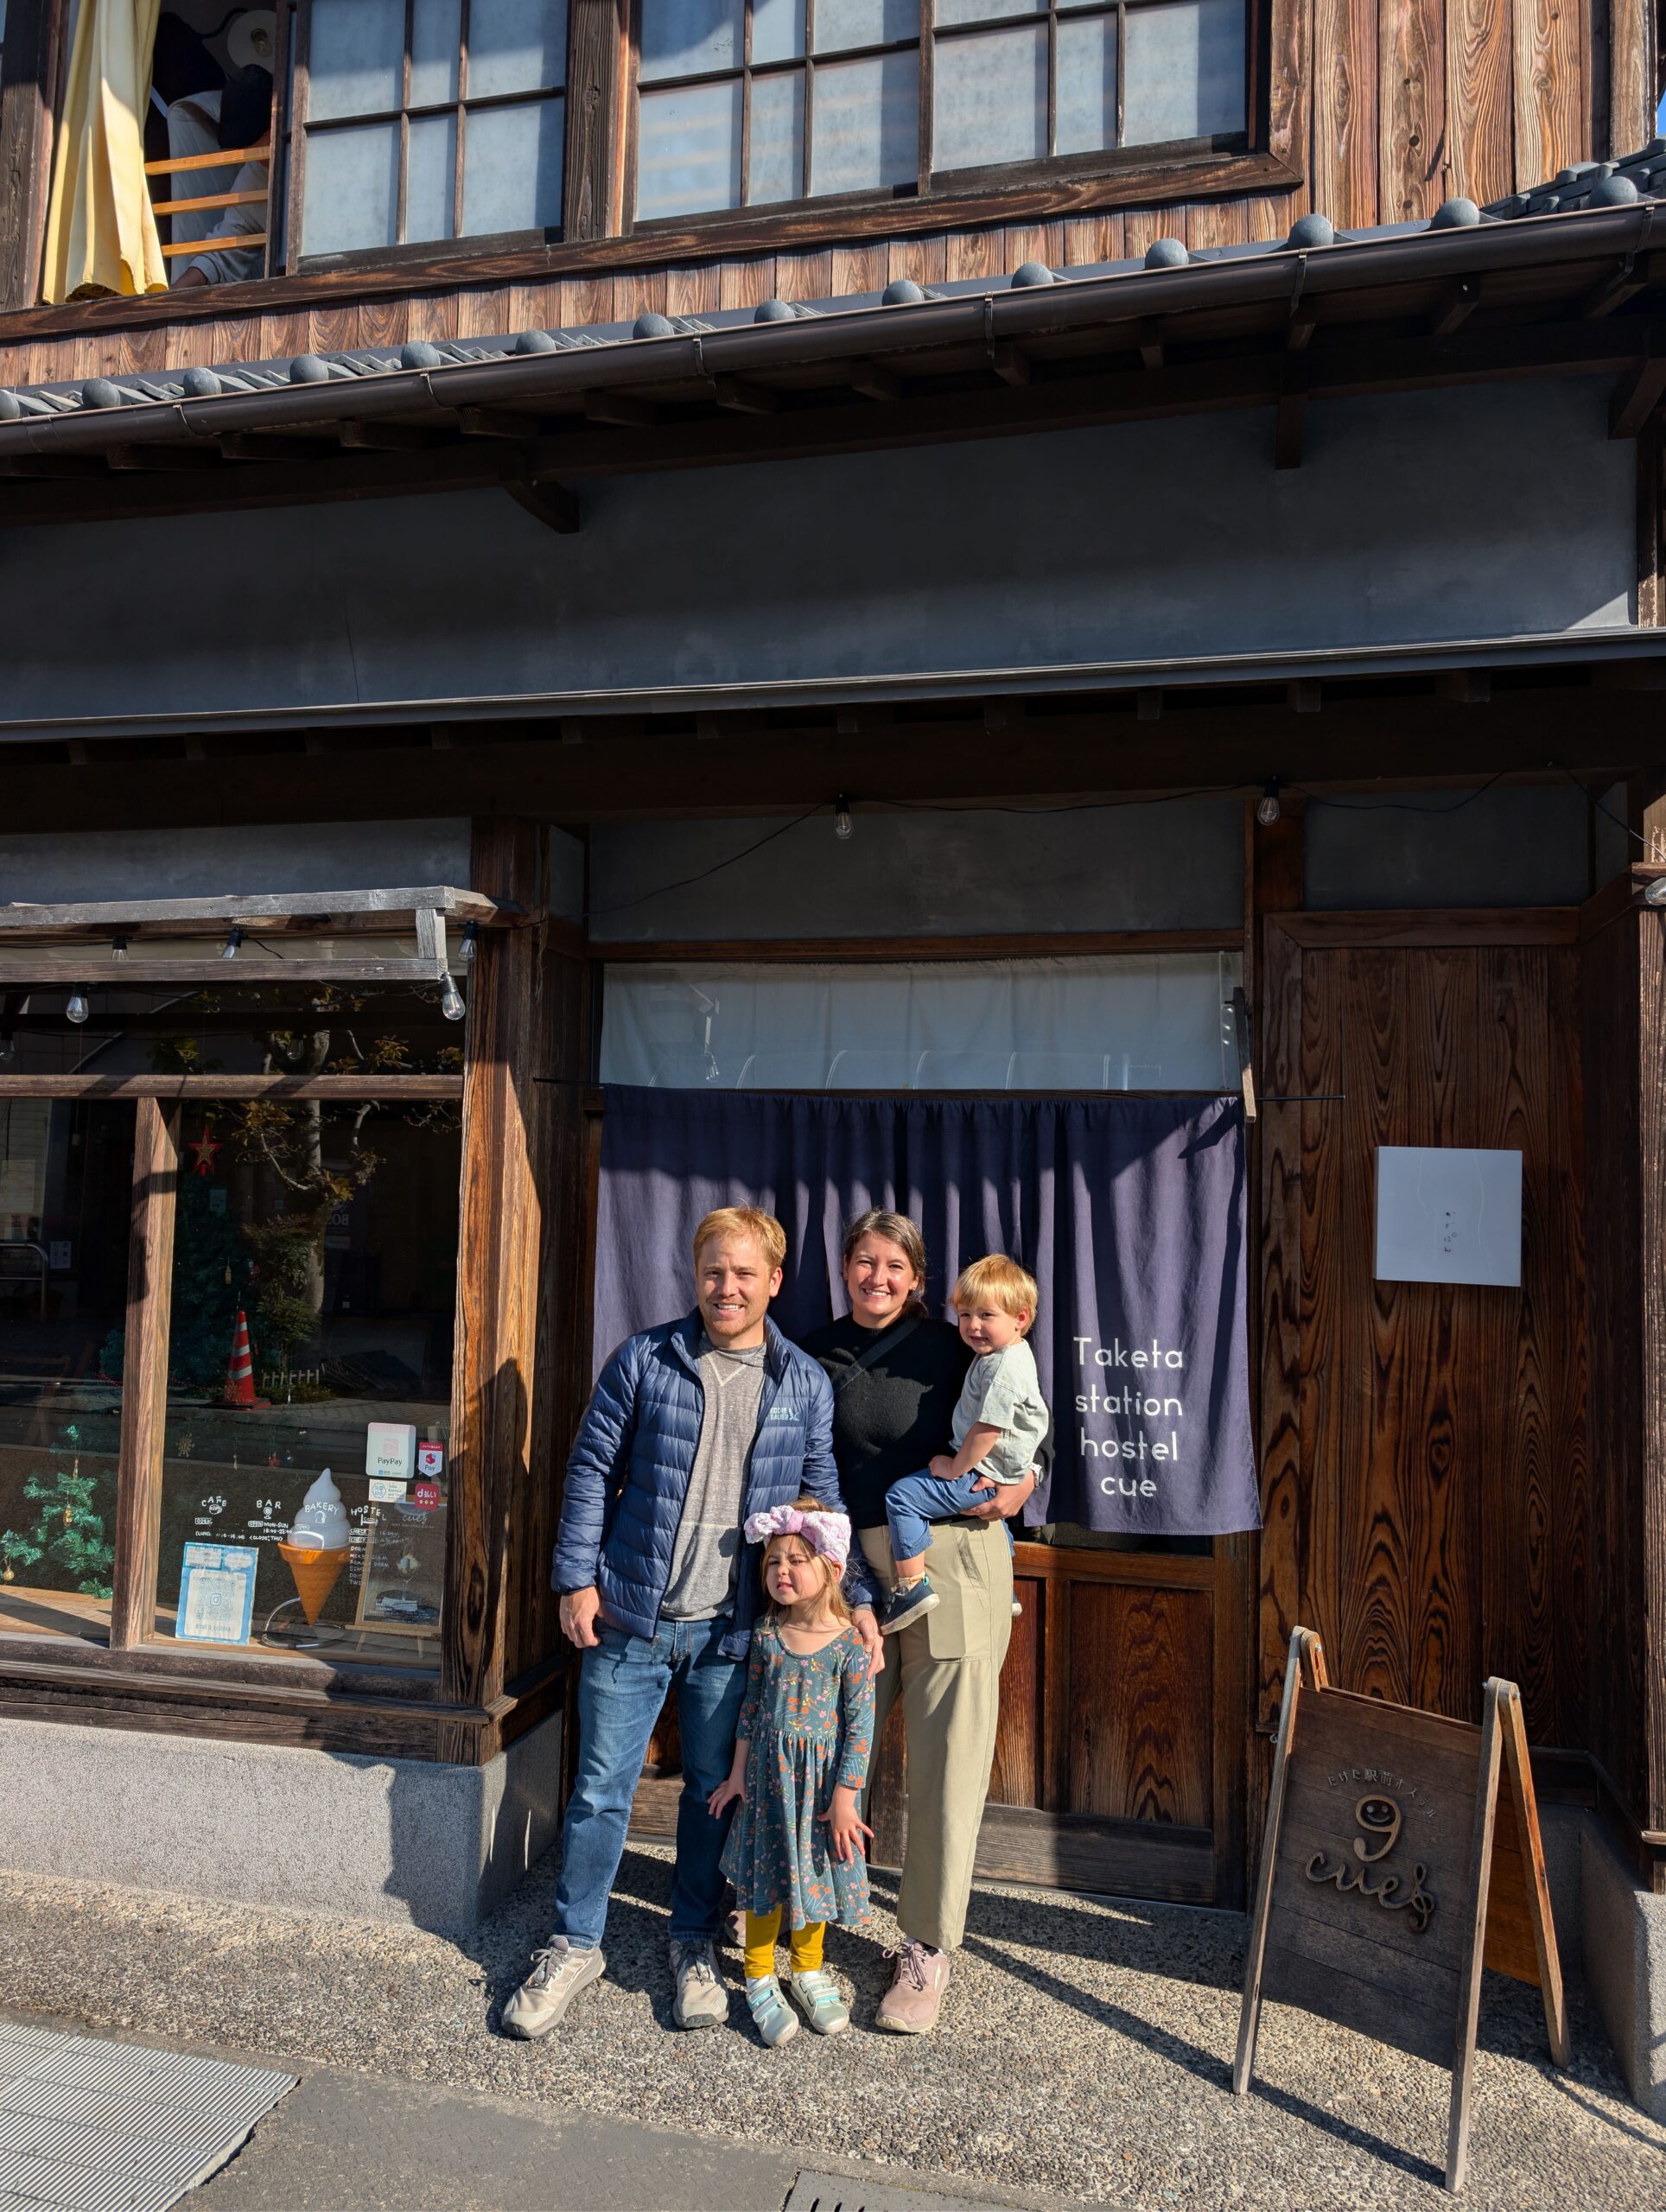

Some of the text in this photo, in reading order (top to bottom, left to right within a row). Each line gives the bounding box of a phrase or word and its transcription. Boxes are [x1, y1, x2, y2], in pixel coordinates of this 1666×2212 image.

[1073, 1337, 1183, 1369] Taketa
[1075, 1384, 1183, 1416] station
[1080, 1427, 1178, 1460] hostel
[378, 1456, 403, 1466] PayPay
[1100, 1476, 1158, 1497] cue
[201, 1496, 227, 1507] CAFE
[256, 1499, 282, 1510] BAR
[304, 1501, 340, 1516] BAKERY
[351, 1504, 387, 1521] HOSTEL
